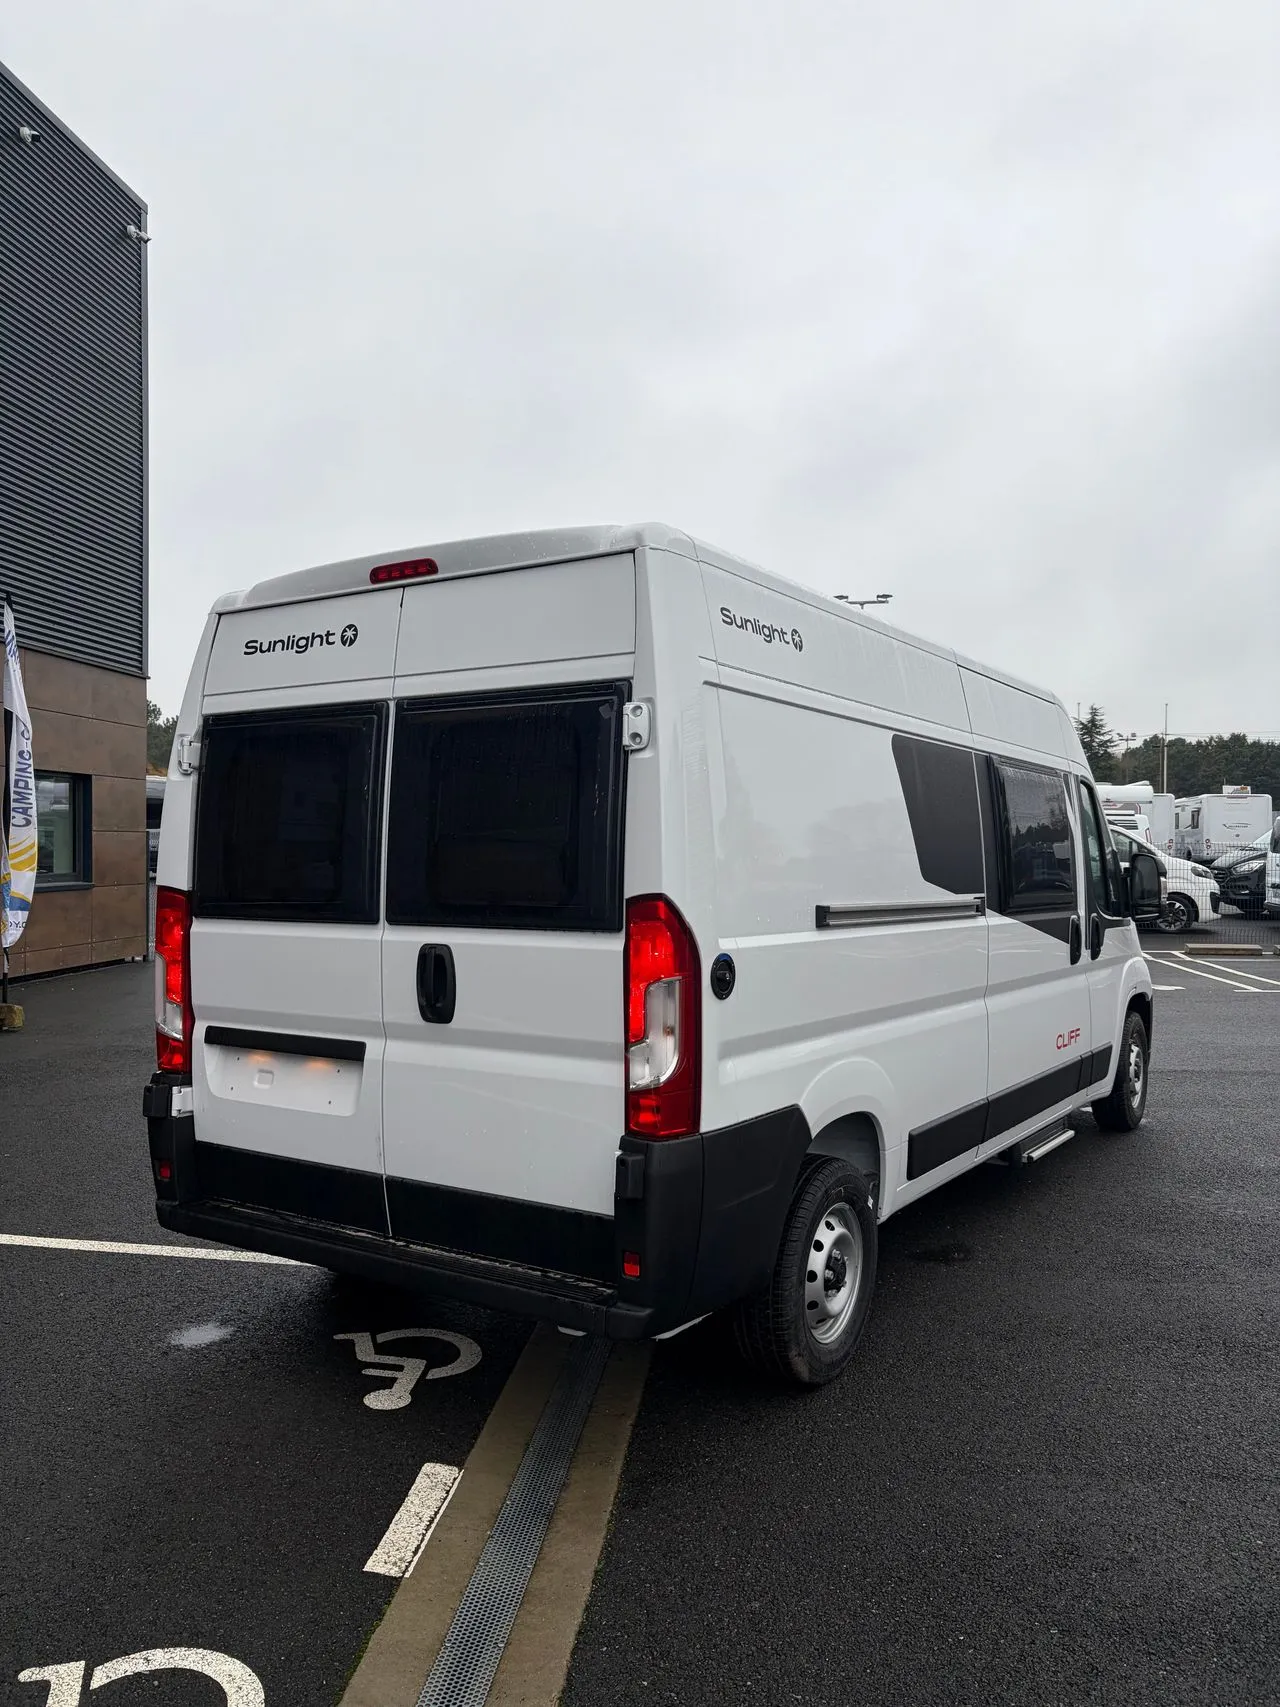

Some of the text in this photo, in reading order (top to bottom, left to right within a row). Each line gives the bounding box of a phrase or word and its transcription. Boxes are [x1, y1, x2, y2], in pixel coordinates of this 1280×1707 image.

[720, 606, 790, 645] Sunlight
[243, 630, 336, 655] Sunlight
[1056, 1027, 1081, 1050] CLIFF
